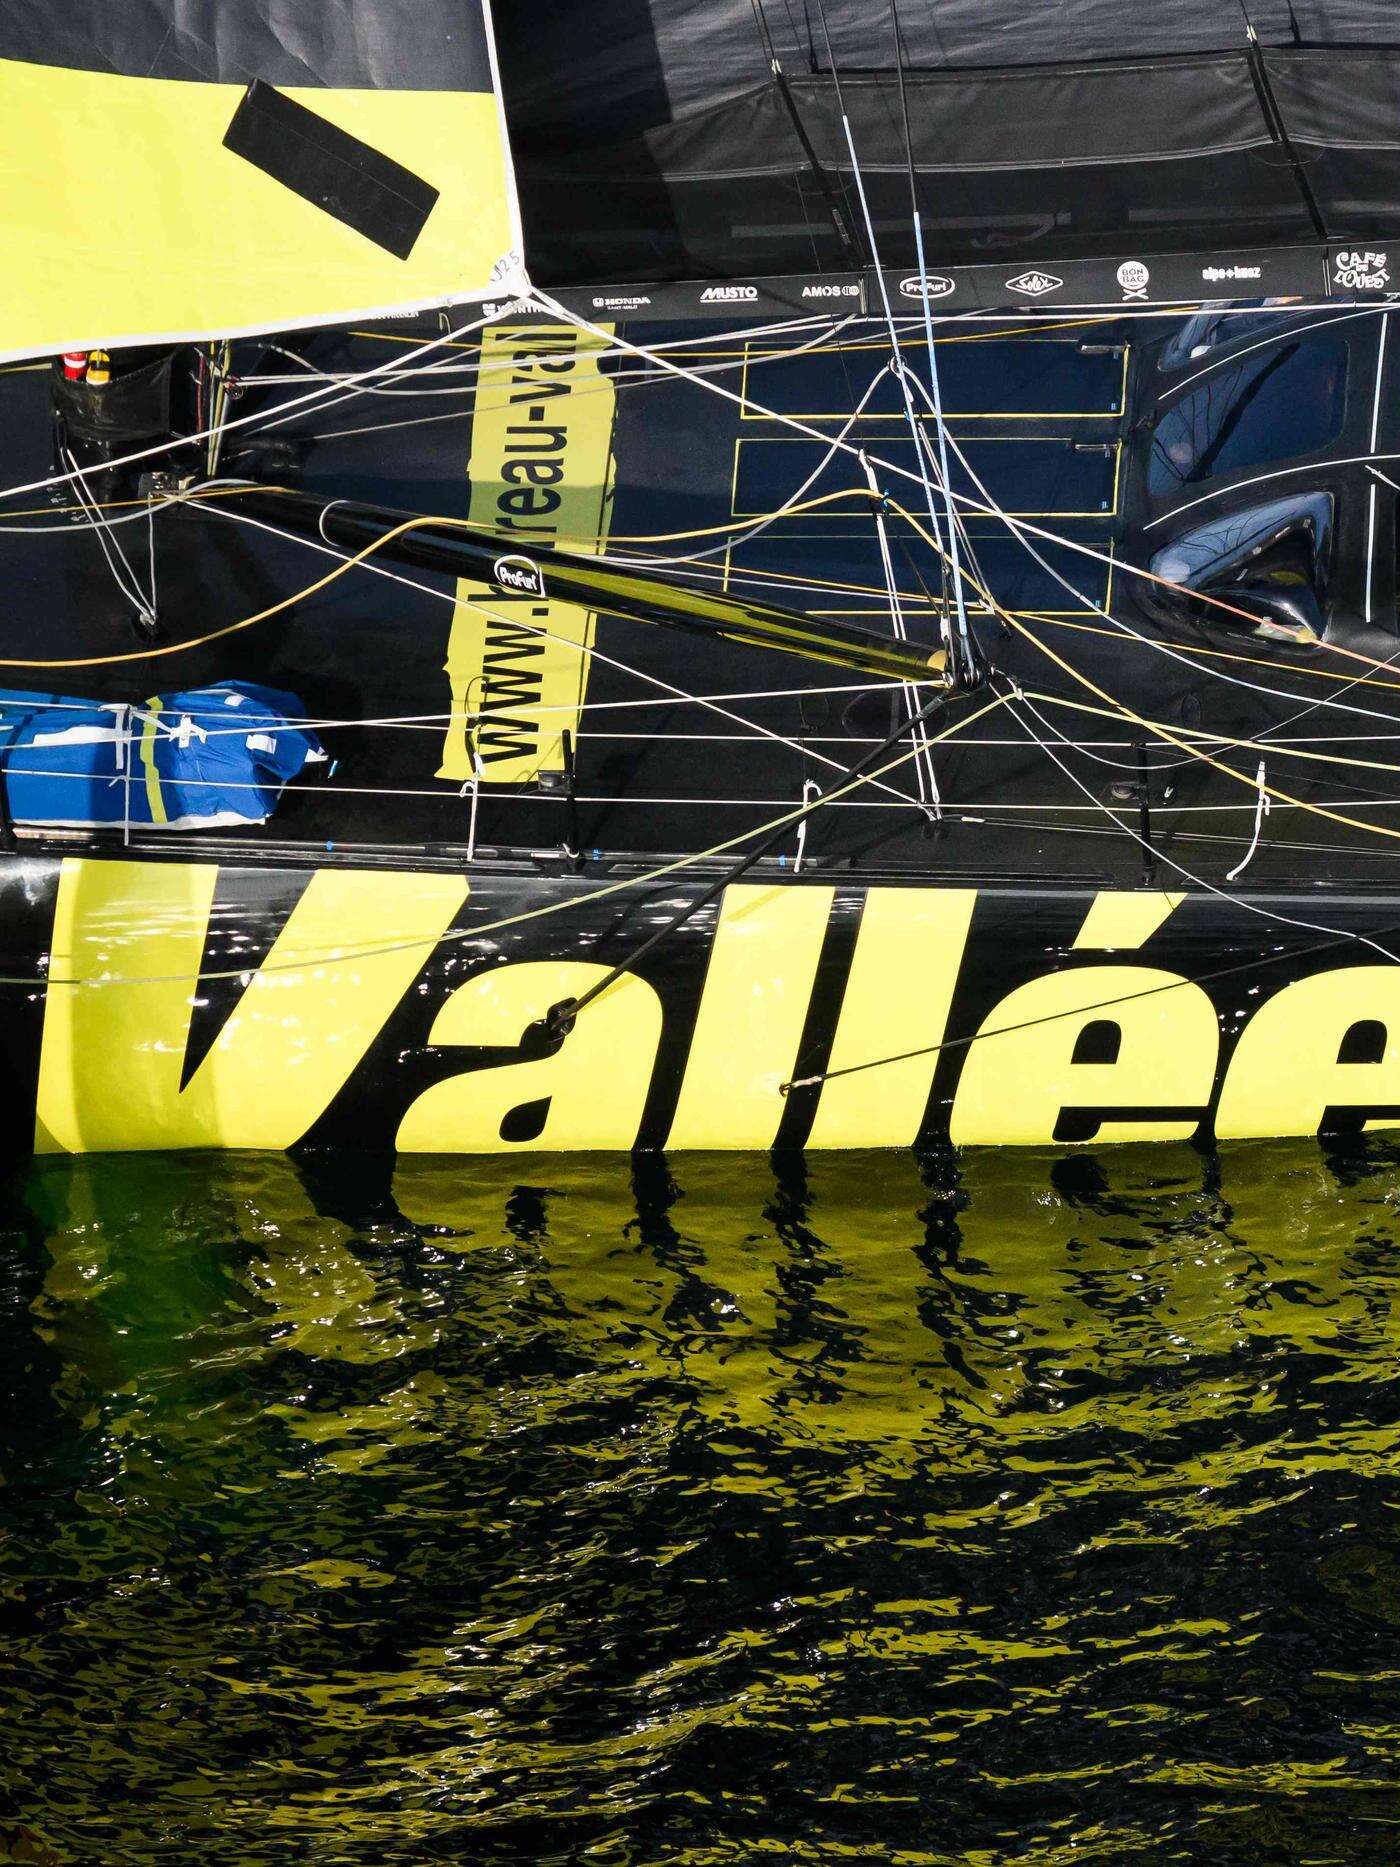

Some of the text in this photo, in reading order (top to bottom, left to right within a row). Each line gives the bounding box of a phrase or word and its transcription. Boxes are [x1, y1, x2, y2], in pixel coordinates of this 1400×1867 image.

[1335, 251, 1387, 271] CAFÉ
[1122, 267, 1144, 276] BON
[700, 286, 758, 300] MUSTO
[801, 285, 841, 297] AMOS
[604, 296, 651, 306] HONDA
